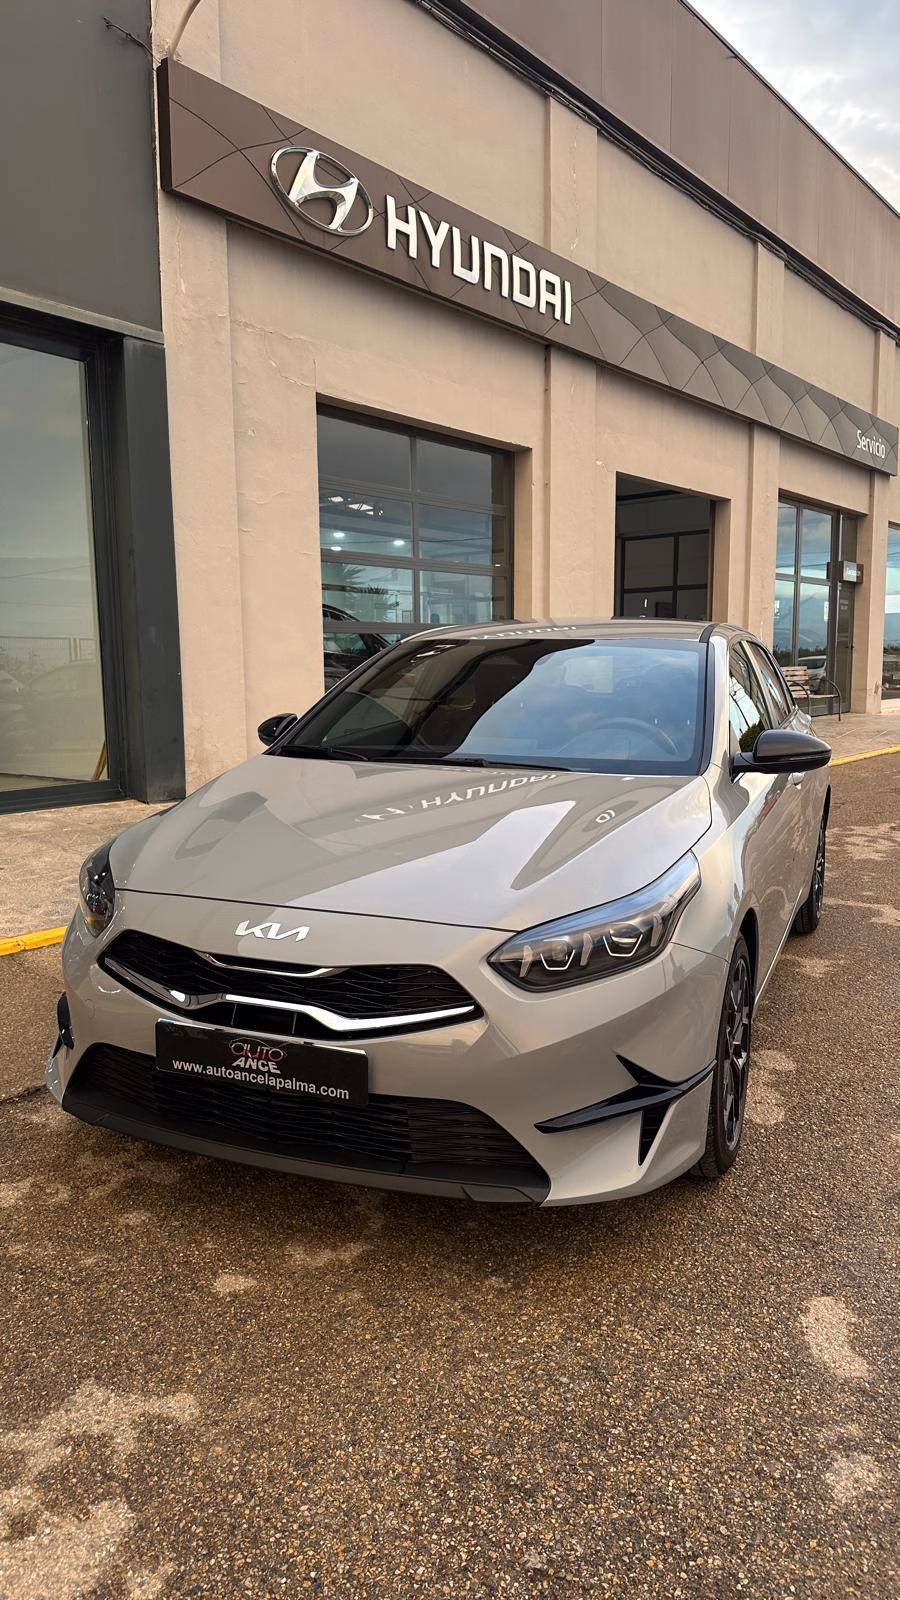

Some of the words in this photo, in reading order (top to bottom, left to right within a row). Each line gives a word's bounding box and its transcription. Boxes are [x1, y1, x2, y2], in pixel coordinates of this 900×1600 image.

[385, 194, 572, 325] HYUNDAI
[856, 429, 886, 459] Servicio
[234, 919, 311, 942] KIA
[172, 1058, 350, 1100] www.autoancelapalma.com
[231, 1056, 281, 1074] ANCE
